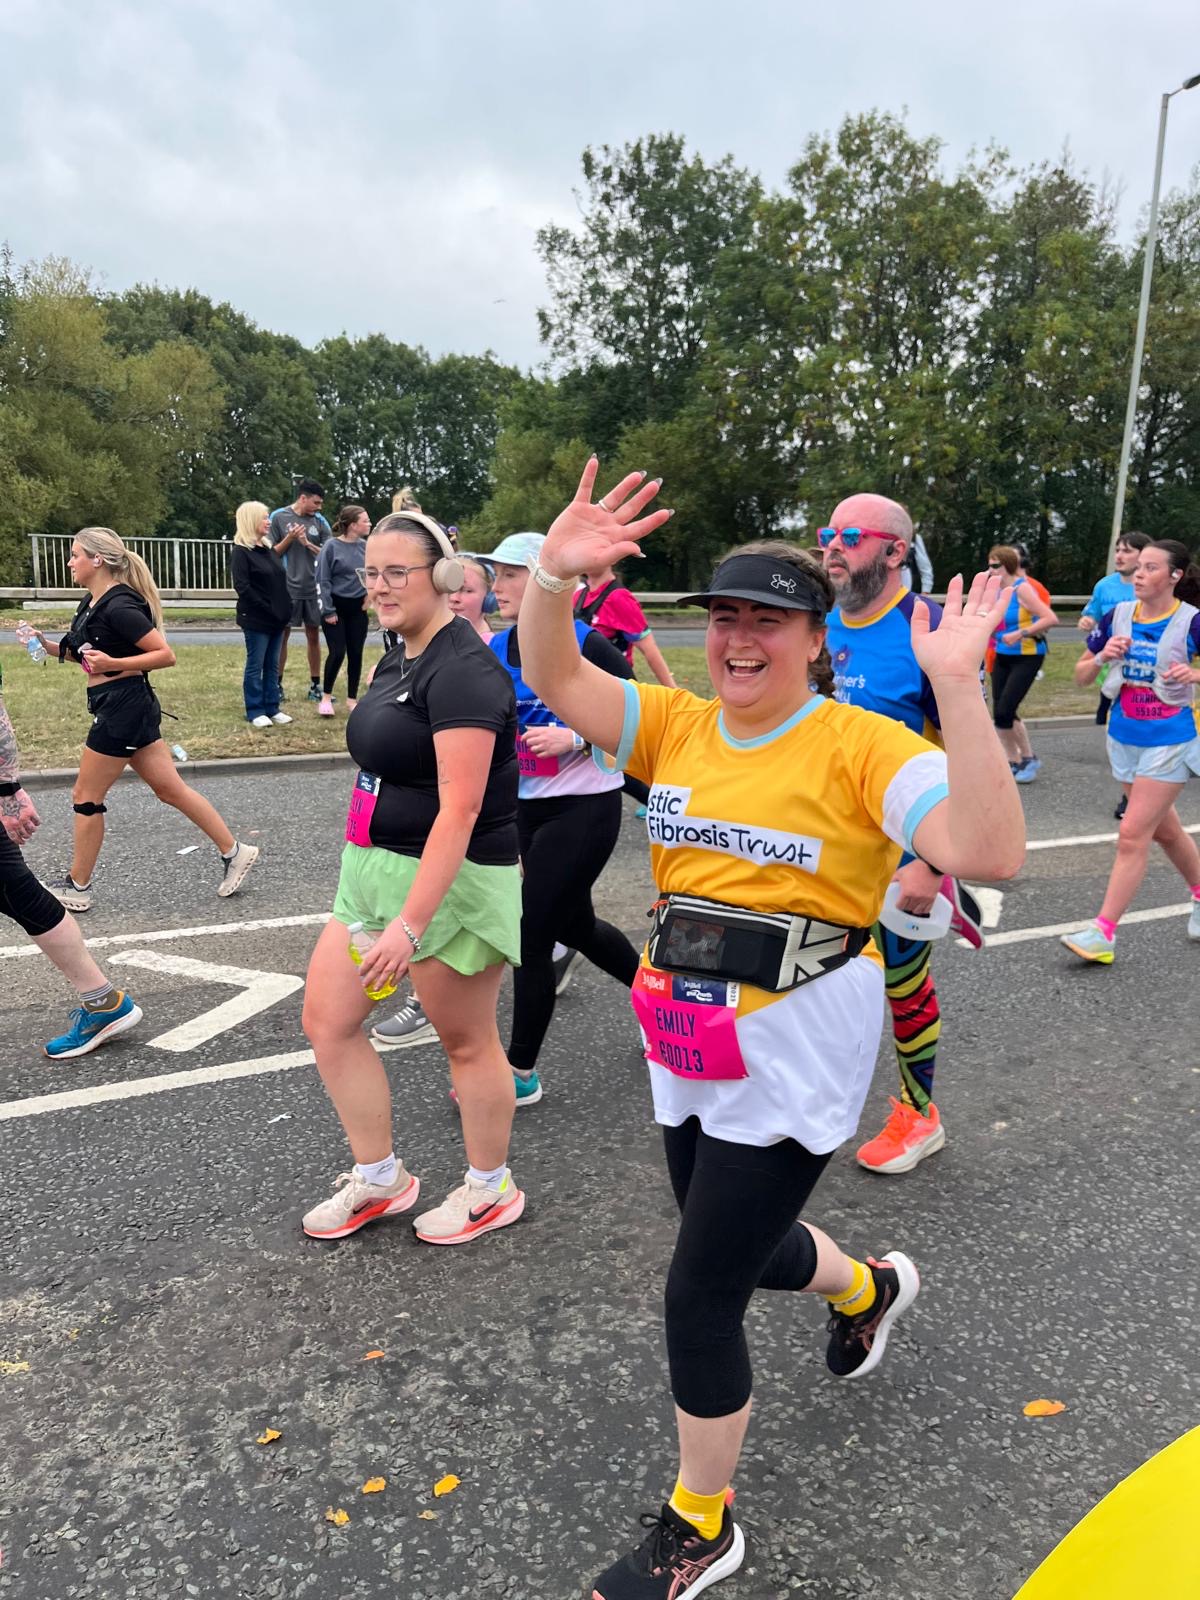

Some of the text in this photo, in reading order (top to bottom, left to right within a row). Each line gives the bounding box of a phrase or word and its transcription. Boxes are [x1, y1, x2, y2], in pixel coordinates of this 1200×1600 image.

[649, 790, 682, 815] stic
[649, 815, 813, 865] Fibrosis Trust
[656, 1008, 695, 1038] EMILY
[659, 1041, 704, 1073] 60013
